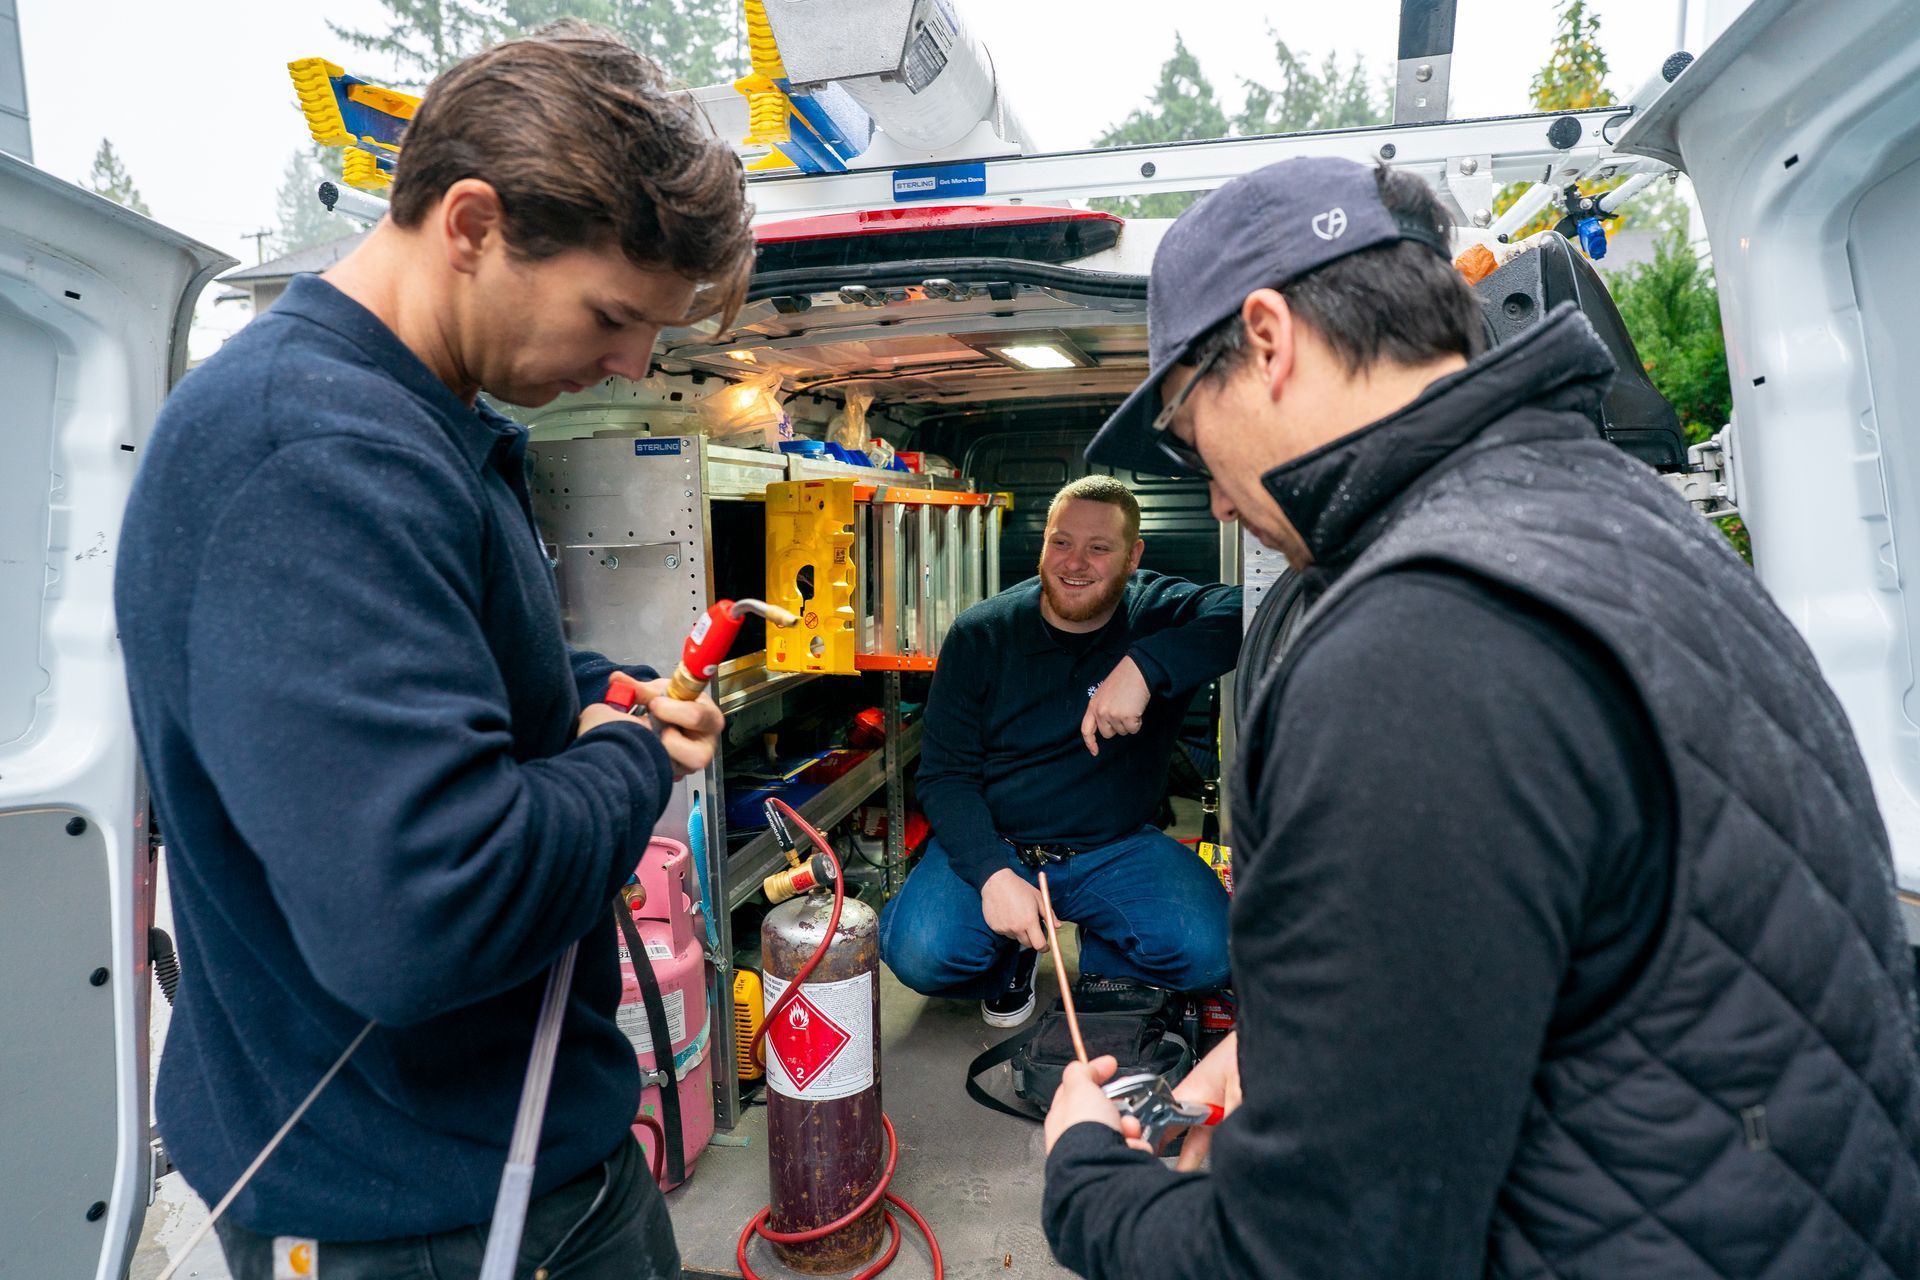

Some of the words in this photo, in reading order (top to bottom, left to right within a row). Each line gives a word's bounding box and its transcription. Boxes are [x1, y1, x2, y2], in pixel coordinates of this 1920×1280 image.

[897, 181, 933, 189] STERLING
[637, 443, 679, 451] STERLING
[796, 1067, 804, 1079] 2
